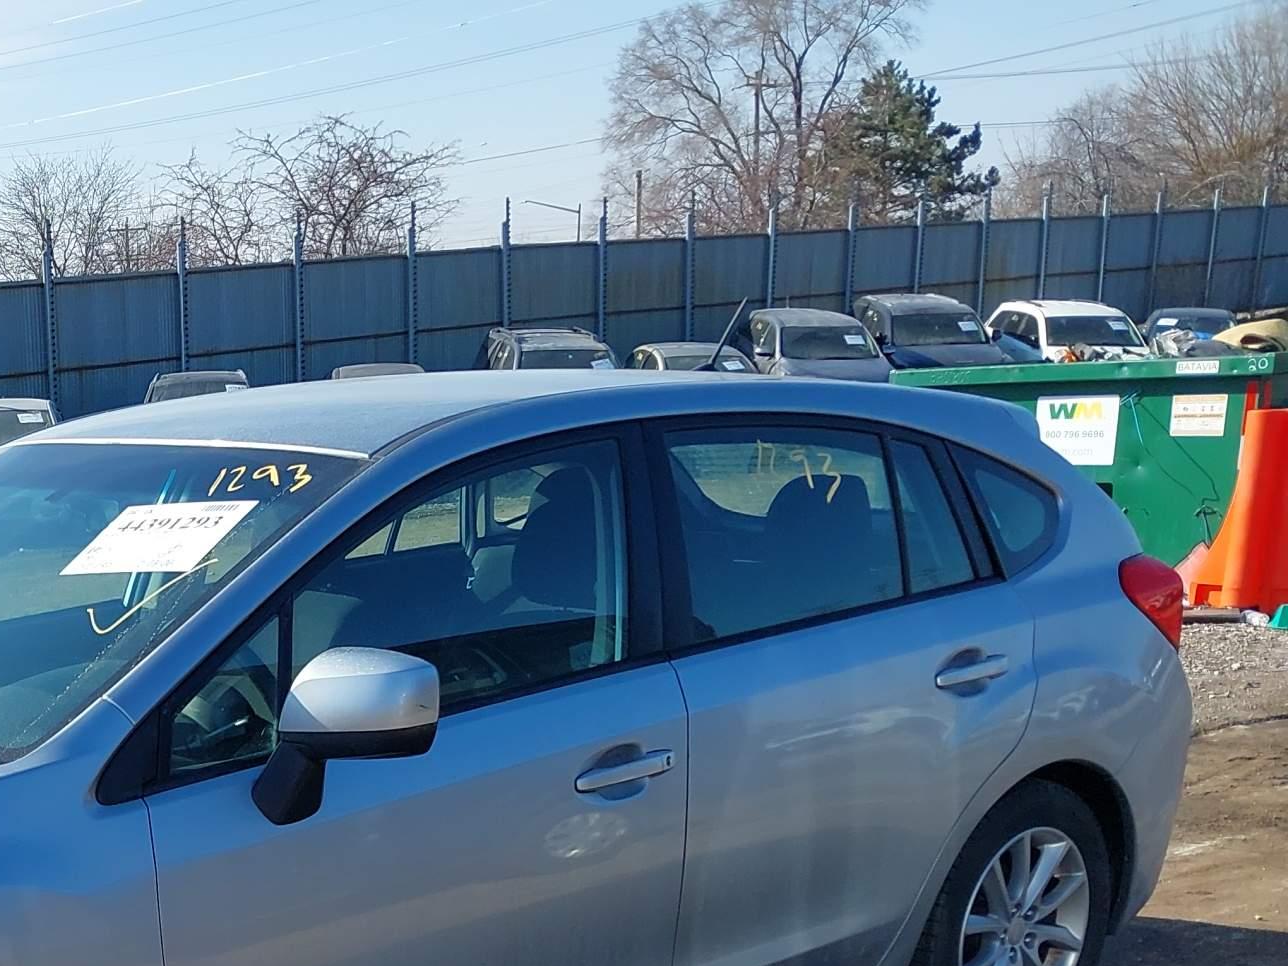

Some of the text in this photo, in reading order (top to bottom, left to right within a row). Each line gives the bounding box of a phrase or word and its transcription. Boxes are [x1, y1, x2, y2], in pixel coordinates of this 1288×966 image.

[1178, 361, 1218, 372] BATAVIA
[1049, 402, 1104, 420] WM
[208, 463, 313, 497] 1293
[118, 515, 224, 533] 44391293
